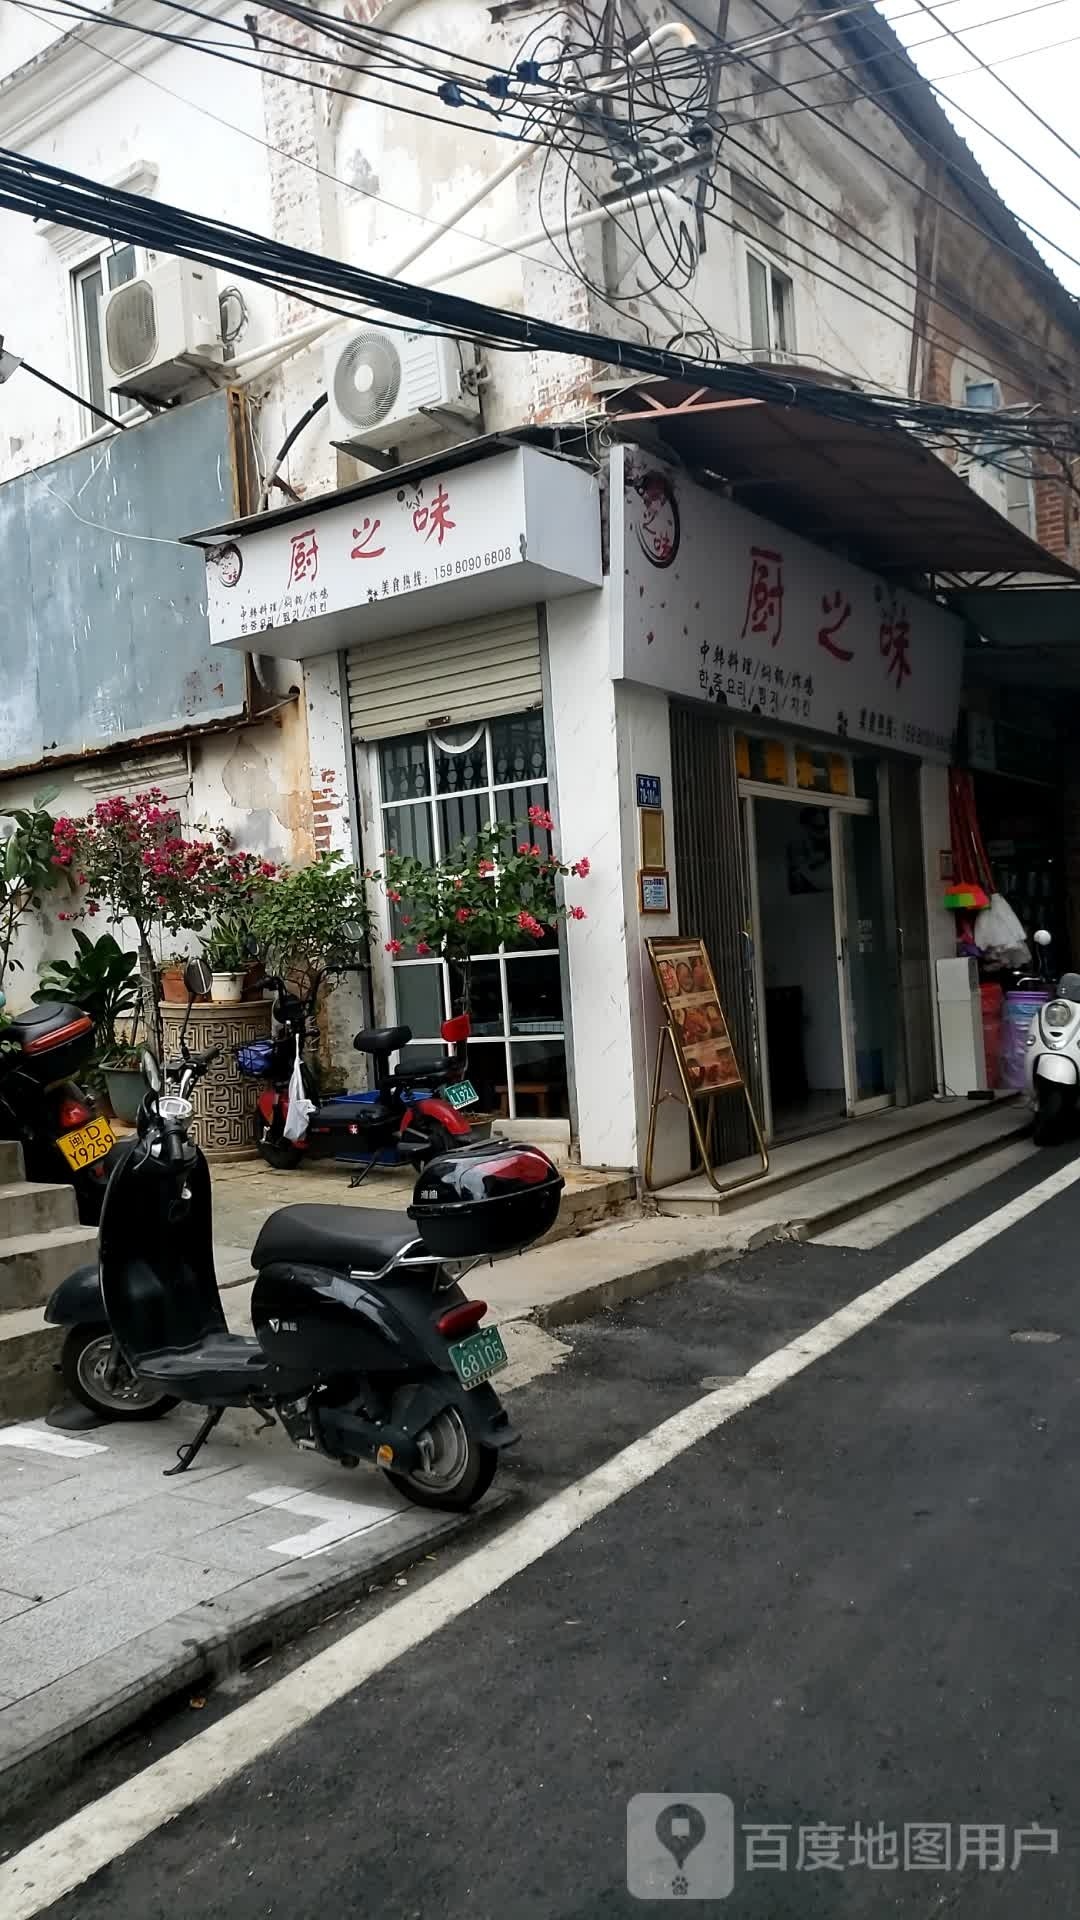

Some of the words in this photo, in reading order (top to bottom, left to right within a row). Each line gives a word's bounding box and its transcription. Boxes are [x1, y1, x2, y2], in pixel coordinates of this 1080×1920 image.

[288, 484, 457, 591] 厨之味
[434, 563, 453, 580] 159
[455, 555, 482, 575] 8090
[484, 547, 512, 567] 6808
[742, 546, 913, 689] 厨之味
[69, 1133, 114, 1166] Y9259
[460, 1340, 503, 1377] 68105
